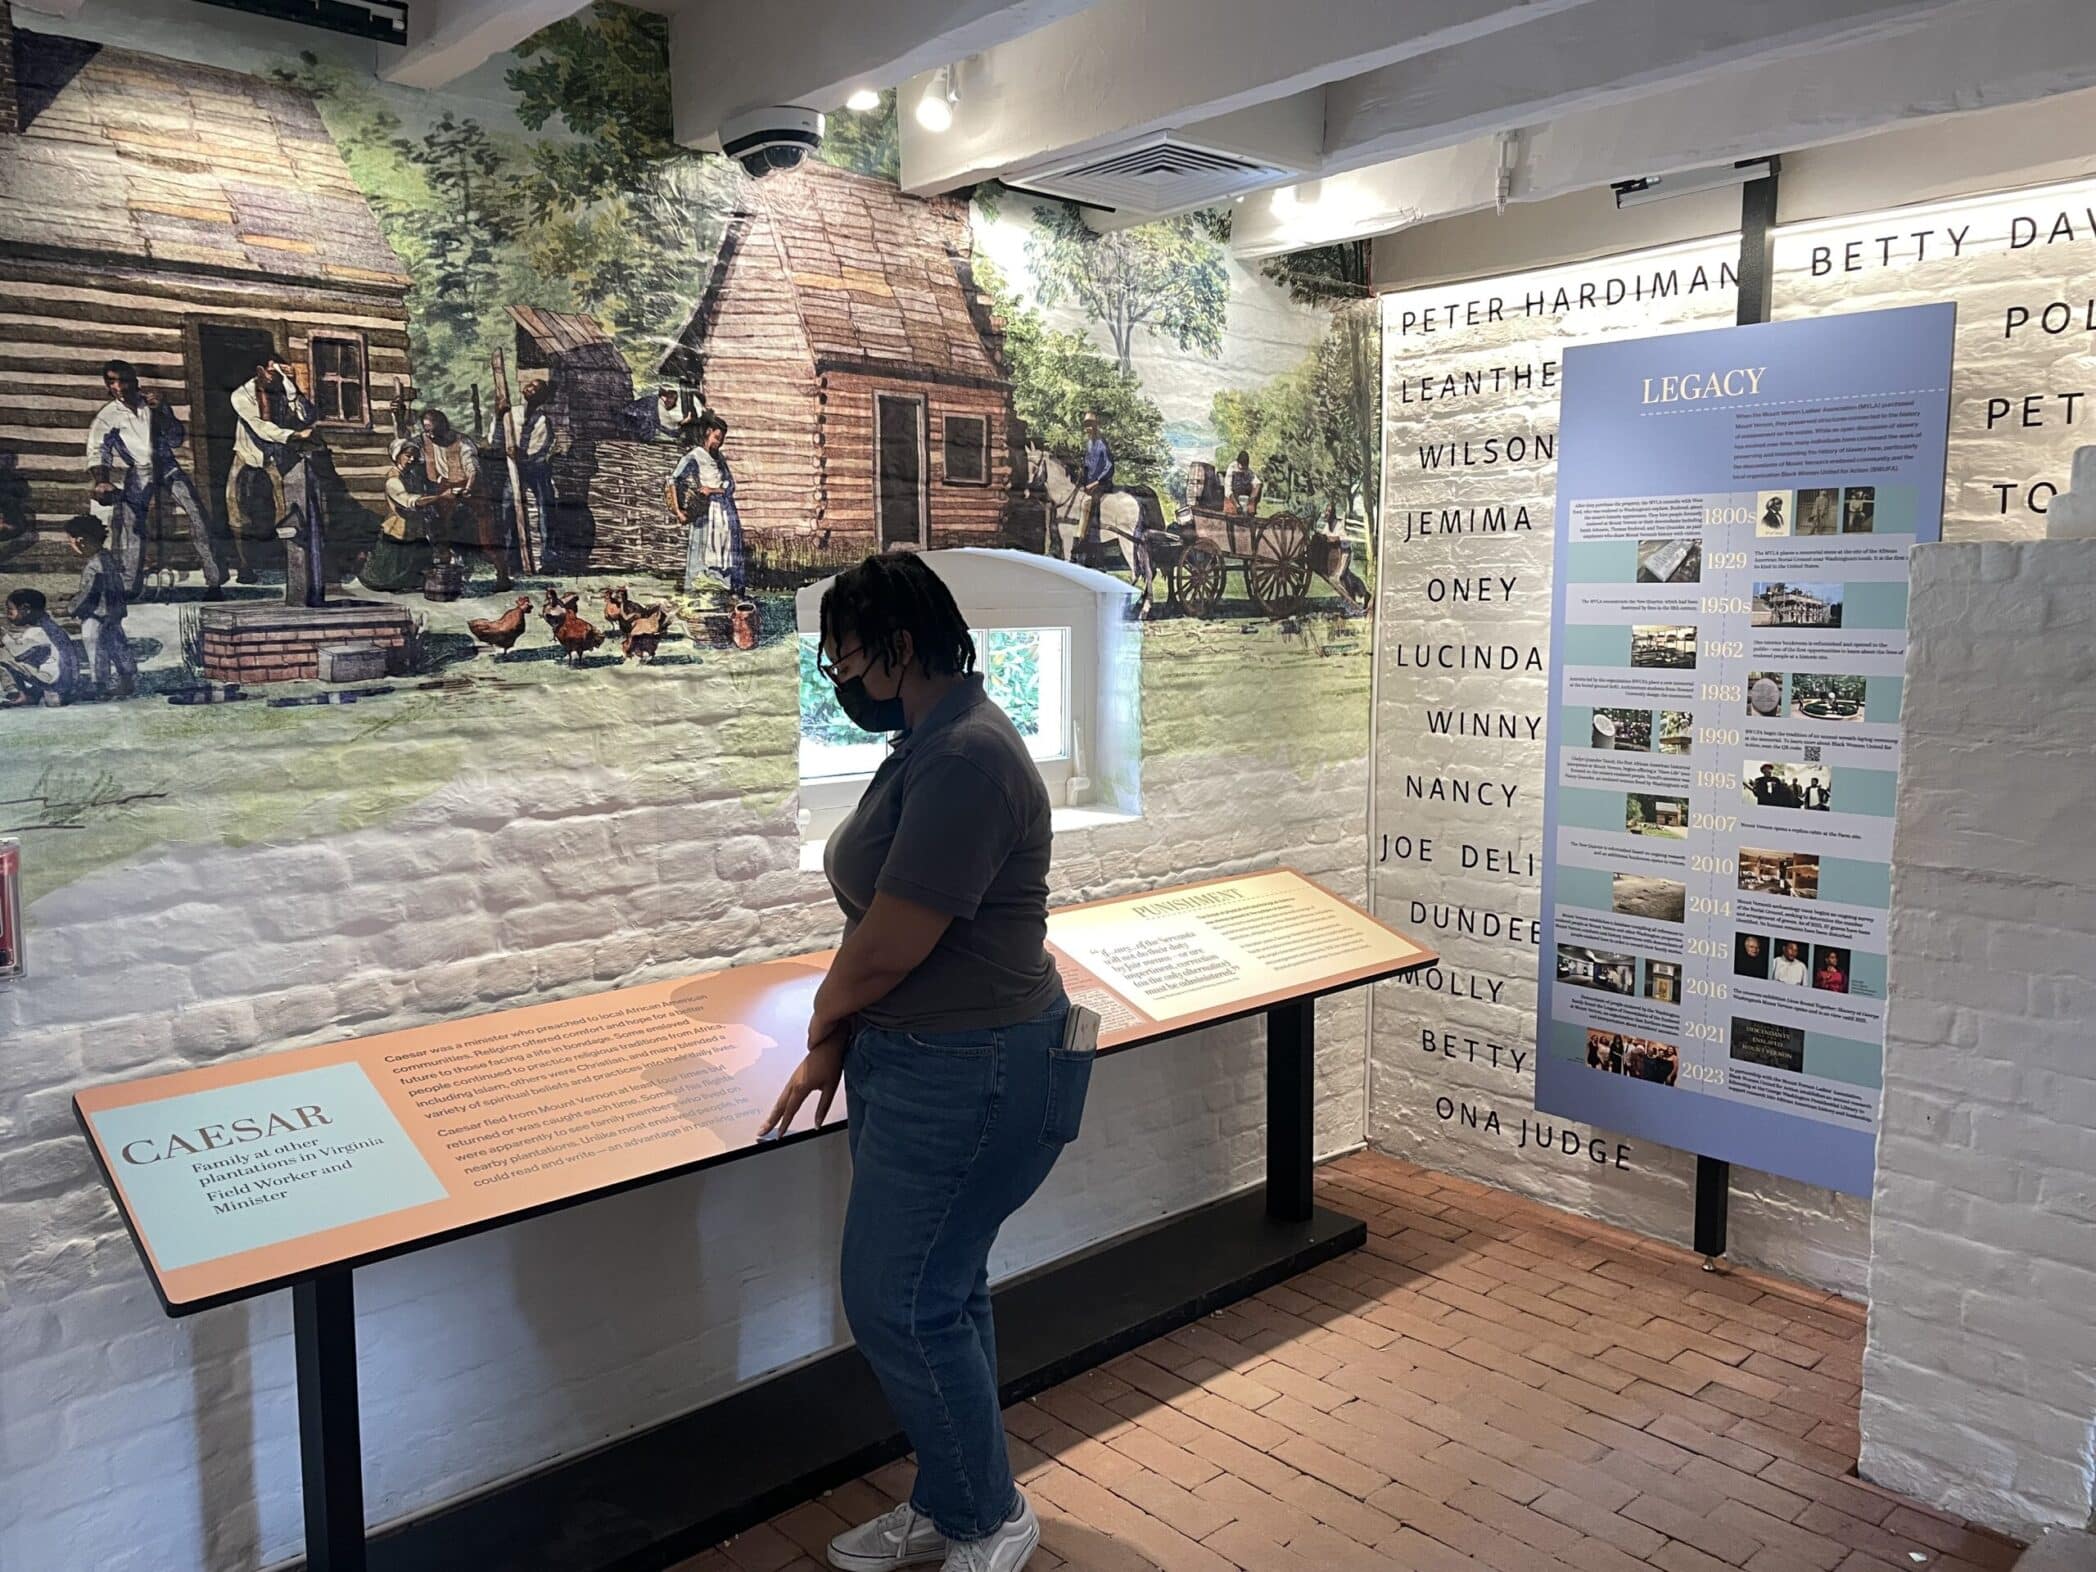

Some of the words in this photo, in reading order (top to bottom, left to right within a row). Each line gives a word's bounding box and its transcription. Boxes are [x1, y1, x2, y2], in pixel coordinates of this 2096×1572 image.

[1811, 225, 1970, 277] BETTY
[1401, 297, 1504, 336] PETER
[1525, 262, 1740, 318] HARDIMAN
[2005, 299, 2096, 338] POL
[1401, 361, 1557, 404] LEANTHE
[1640, 366, 1768, 404] LEGACY
[1987, 392, 2085, 430] PET
[1418, 434, 1553, 469] WILSON
[1403, 506, 1533, 543] JEMIMA
[1707, 551, 1747, 570] 1929
[1427, 577, 1517, 602] ONEY
[1700, 596, 1751, 615] 1950s
[1397, 644, 1543, 671] LUCINDA
[1703, 640, 1744, 658] 1962
[1700, 683, 1741, 702] 1983
[1427, 710, 1541, 740] WINNY
[1699, 727, 1740, 746] 1990
[1406, 775, 1518, 808] NANCY
[1696, 770, 1736, 790] 1995
[1691, 813, 1737, 833] 2007
[1380, 834, 1432, 862] JOE
[1461, 844, 1534, 877] DELI
[1691, 855, 1734, 875] 2010
[1132, 888, 1244, 918] PUNISHMENT
[1689, 896, 1732, 917] 2014
[1410, 900, 1541, 945] DUNDEE
[1687, 937, 1729, 959] 2015
[1399, 967, 1504, 1003] MOLLY
[1686, 978, 1727, 1000] 2016
[383, 1050, 427, 1062] Caesar
[430, 1045, 453, 1053] was
[464, 1034, 509, 1046] minister
[535, 1017, 585, 1033] preached
[597, 1009, 625, 1019] local
[623, 1003, 661, 1013] African
[392, 1054, 473, 1073] communities.
[472, 1043, 520, 1056] Religion
[521, 1034, 561, 1046] offered
[562, 1025, 605, 1038] comfort
[605, 1020, 625, 1029] and
[624, 1016, 652, 1024] hope
[399, 1073, 437, 1084] future
[452, 1063, 487, 1073] those
[487, 1055, 525, 1065] facing
[612, 1029, 644, 1039] Some
[645, 1019, 690, 1032] enslaved
[1421, 1029, 1527, 1074] BETTY
[1684, 1021, 1724, 1044] 2021
[408, 1083, 450, 1096] people
[452, 1068, 512, 1086] continued
[526, 1057, 571, 1071] practice
[572, 1046, 619, 1059] religious
[617, 1036, 668, 1049] traditions
[415, 1091, 473, 1107] including
[472, 1084, 509, 1094] Islam,
[509, 1075, 546, 1086] others
[548, 1068, 576, 1077] were
[628, 1051, 649, 1059] and
[650, 1046, 678, 1054] many
[676, 1035, 719, 1048] blended
[1681, 1062, 1724, 1085] 2023
[425, 1105, 468, 1118] variety
[468, 1100, 481, 1108] of
[483, 1089, 531, 1105] spiritual
[530, 1082, 569, 1094] beliefs
[570, 1076, 591, 1085] and
[592, 1065, 643, 1081] practices
[662, 1054, 689, 1063] their
[437, 1122, 482, 1136] Caesar
[482, 1115, 507, 1126] fled
[508, 1109, 537, 1119] from
[538, 1099, 576, 1112] Mount
[575, 1091, 617, 1103] Vernon
[617, 1086, 629, 1094] at
[627, 1080, 656, 1091] least
[707, 1064, 726, 1072] but
[121, 1104, 333, 1166] CAESAR
[446, 1131, 500, 1149] returned
[517, 1123, 540, 1131] was
[542, 1111, 583, 1125] caught
[584, 1104, 612, 1115] each
[640, 1091, 673, 1101] Some
[455, 1149, 486, 1161] were
[488, 1133, 554, 1152] apparently
[568, 1124, 590, 1133] see
[590, 1115, 626, 1127] family
[626, 1103, 677, 1118] members
[678, 1097, 701, 1105] who
[1435, 1096, 1500, 1135] ONA
[1518, 1119, 1631, 1171] JUDGE
[192, 1153, 250, 1173] Family
[254, 1149, 270, 1159] at
[274, 1138, 320, 1154] other
[464, 1159, 509, 1173] nearby
[580, 1131, 617, 1143] Unlike
[618, 1122, 647, 1134] most
[647, 1110, 696, 1126] enslaved
[473, 1172, 509, 1186] could
[510, 1164, 539, 1176] read
[541, 1157, 564, 1168] and
[623, 1129, 682, 1147] advantage
[199, 1156, 297, 1188] plantations
[300, 1152, 317, 1162] in
[319, 1137, 384, 1157] Virginia
[206, 1184, 250, 1202] Field
[254, 1169, 318, 1190] Worker
[322, 1160, 353, 1175] and
[213, 1190, 288, 1215] Minister
